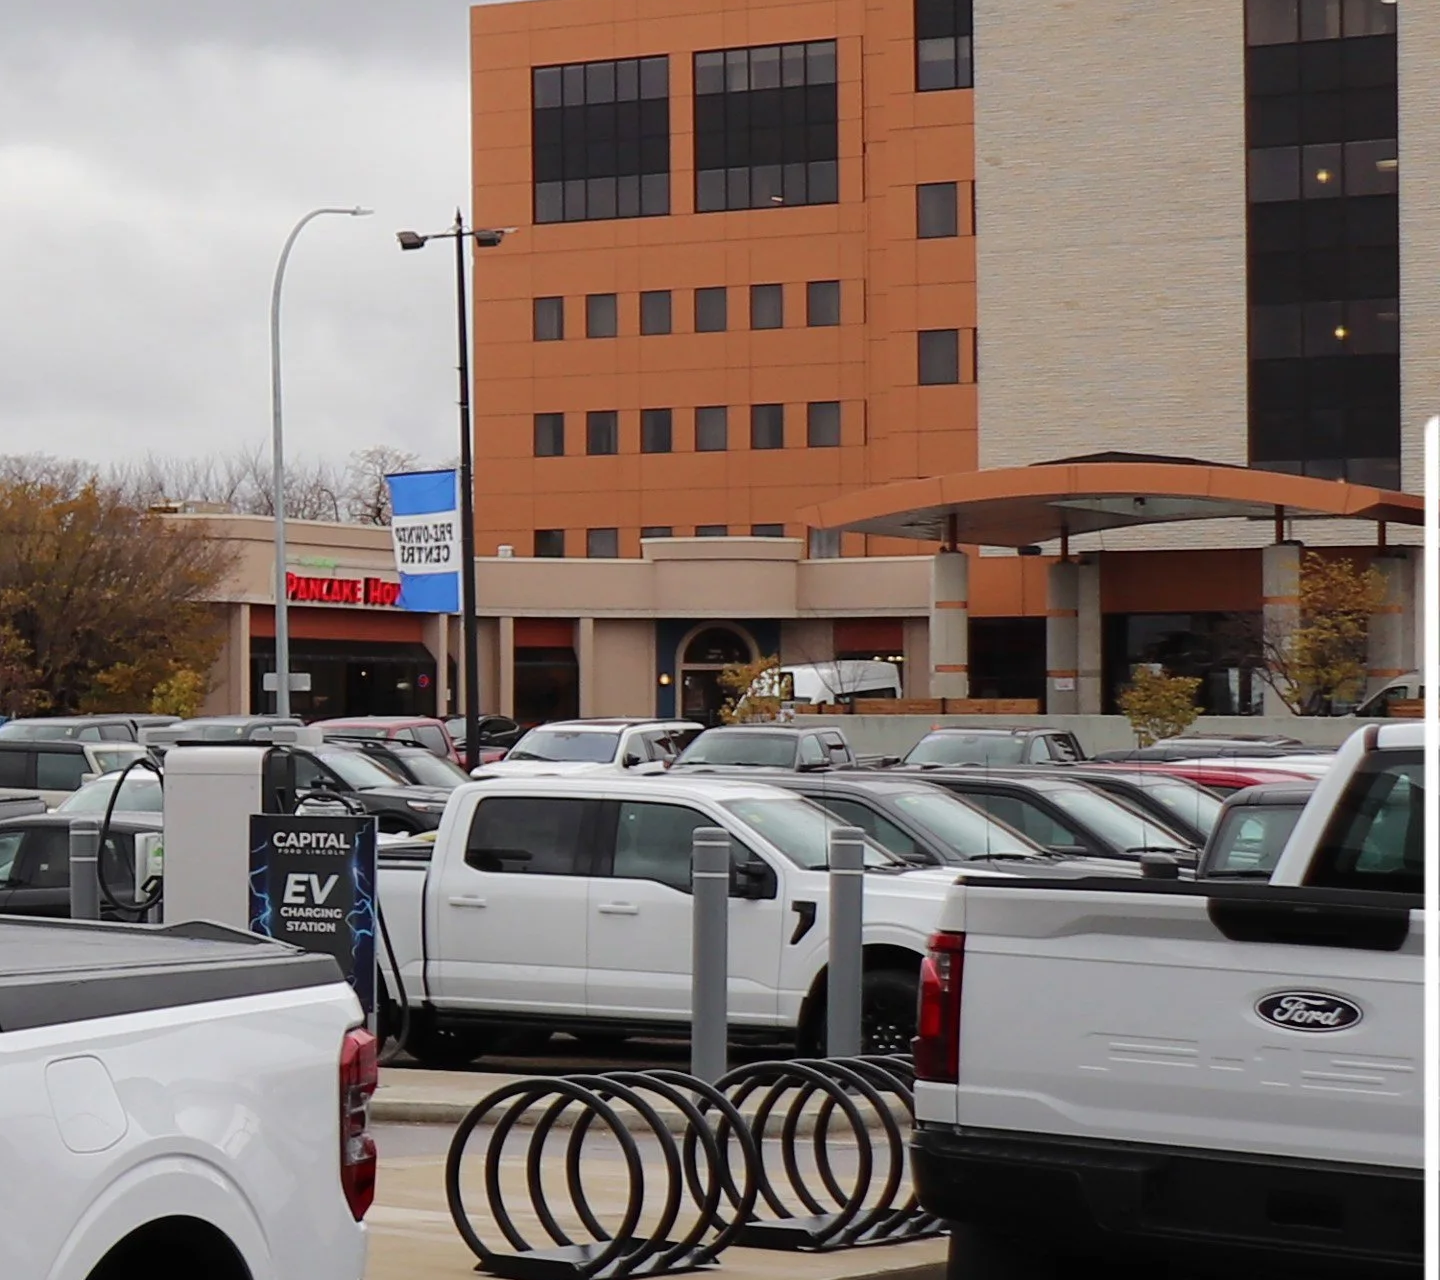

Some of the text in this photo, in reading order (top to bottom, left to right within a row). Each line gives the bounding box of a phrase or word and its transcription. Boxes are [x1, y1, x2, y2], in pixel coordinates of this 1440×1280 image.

[272, 831, 351, 849] CAPITAL
[282, 872, 340, 905] EV
[280, 906, 343, 919] CHARGING
[286, 920, 336, 932] STATION
[1272, 996, 1343, 1026] Ford
